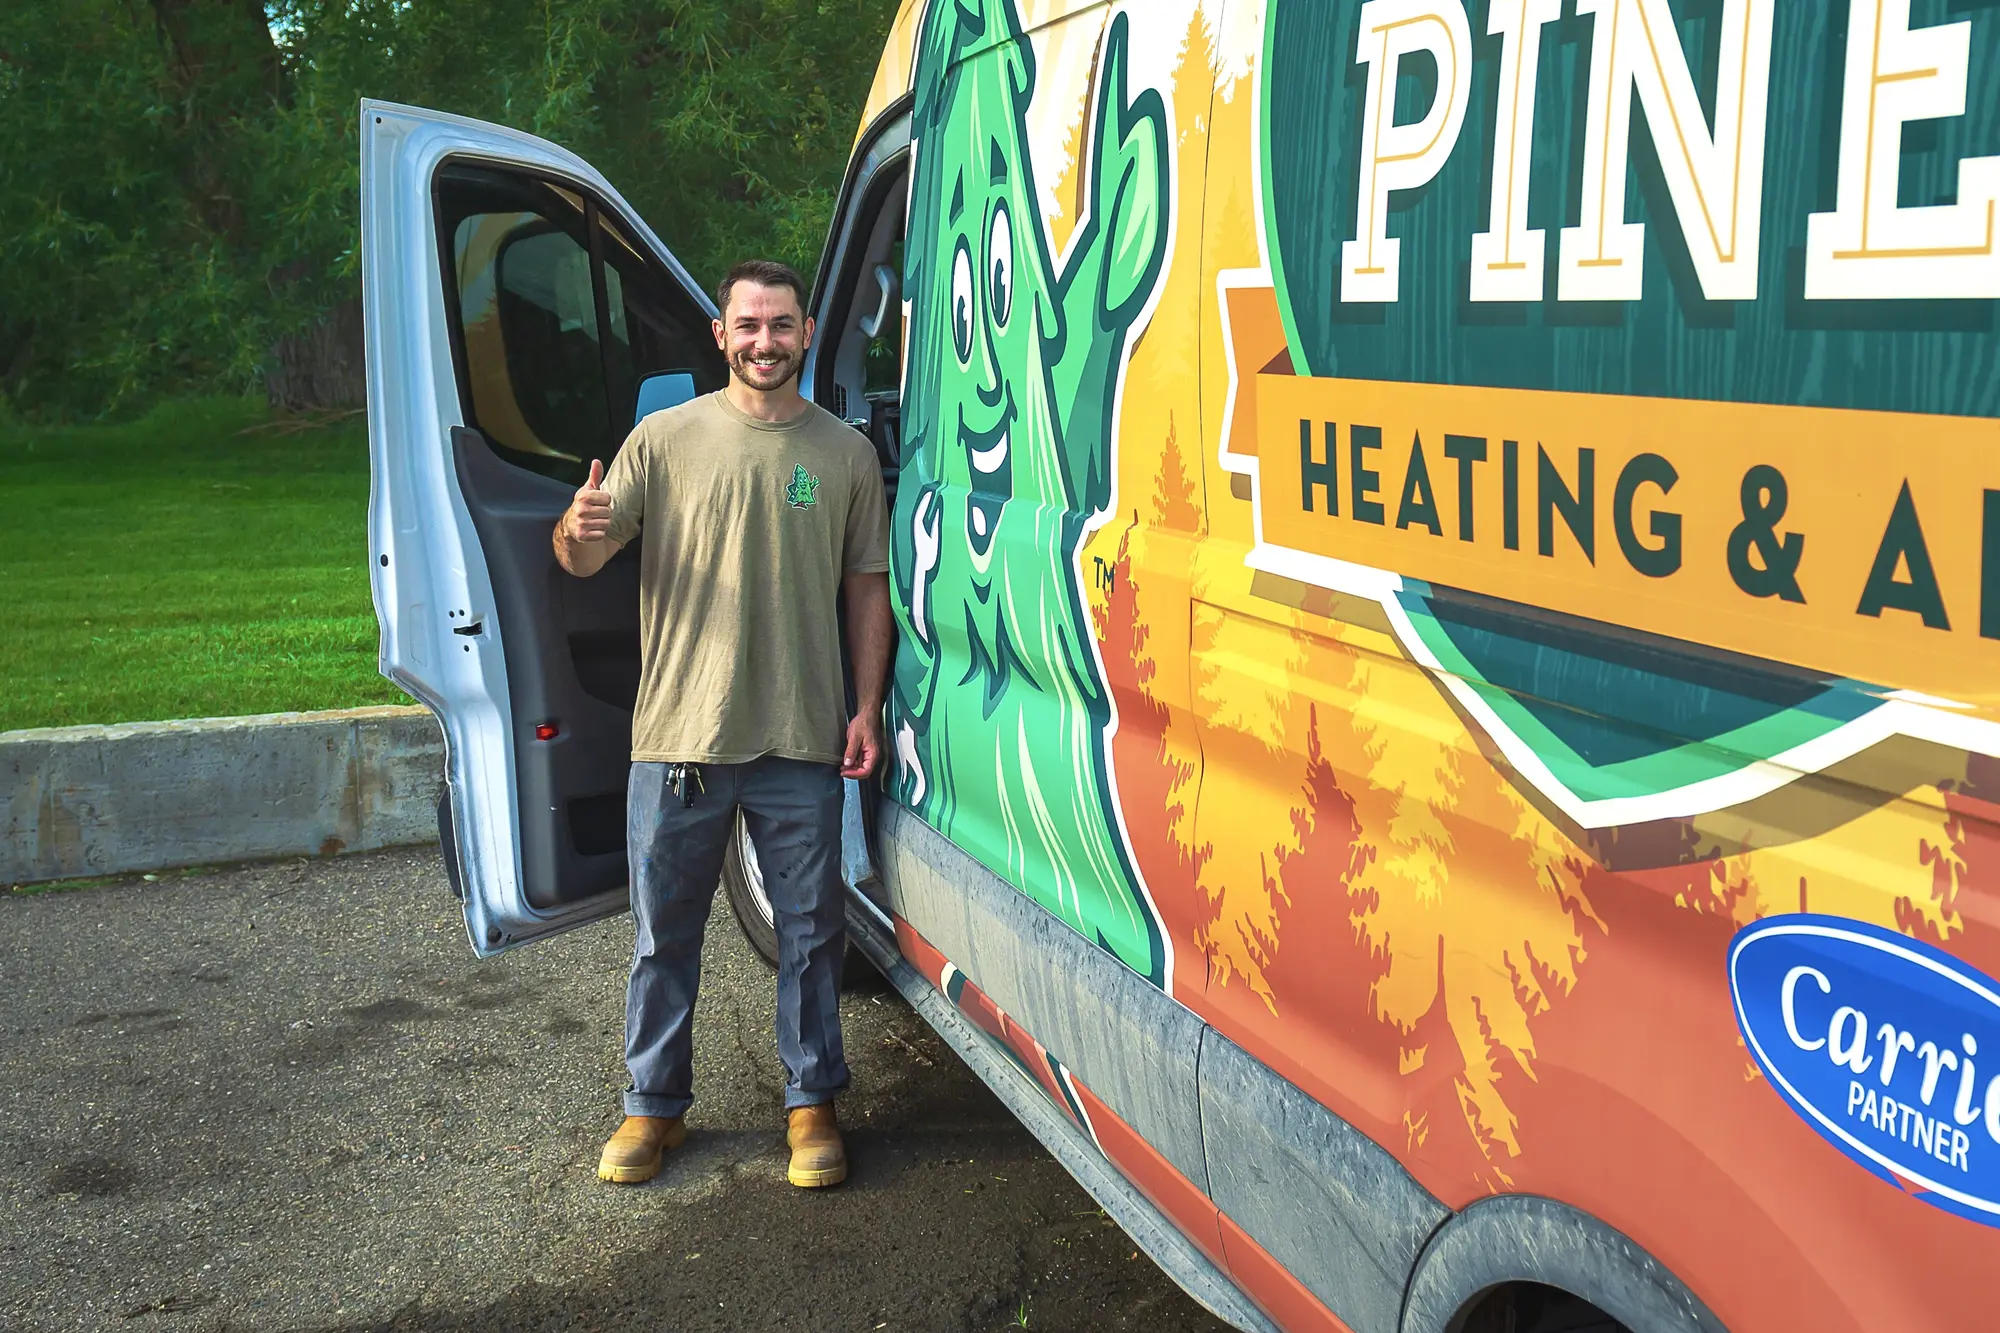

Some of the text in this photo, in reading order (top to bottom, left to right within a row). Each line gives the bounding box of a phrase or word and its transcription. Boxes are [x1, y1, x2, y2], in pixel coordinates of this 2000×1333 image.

[1340, 0, 2000, 302] PINE
[1093, 556, 1115, 593] TM
[1299, 418, 1683, 578] HEATING
[1726, 464, 1807, 604] &
[1847, 1080, 1970, 1173] PARTNER
